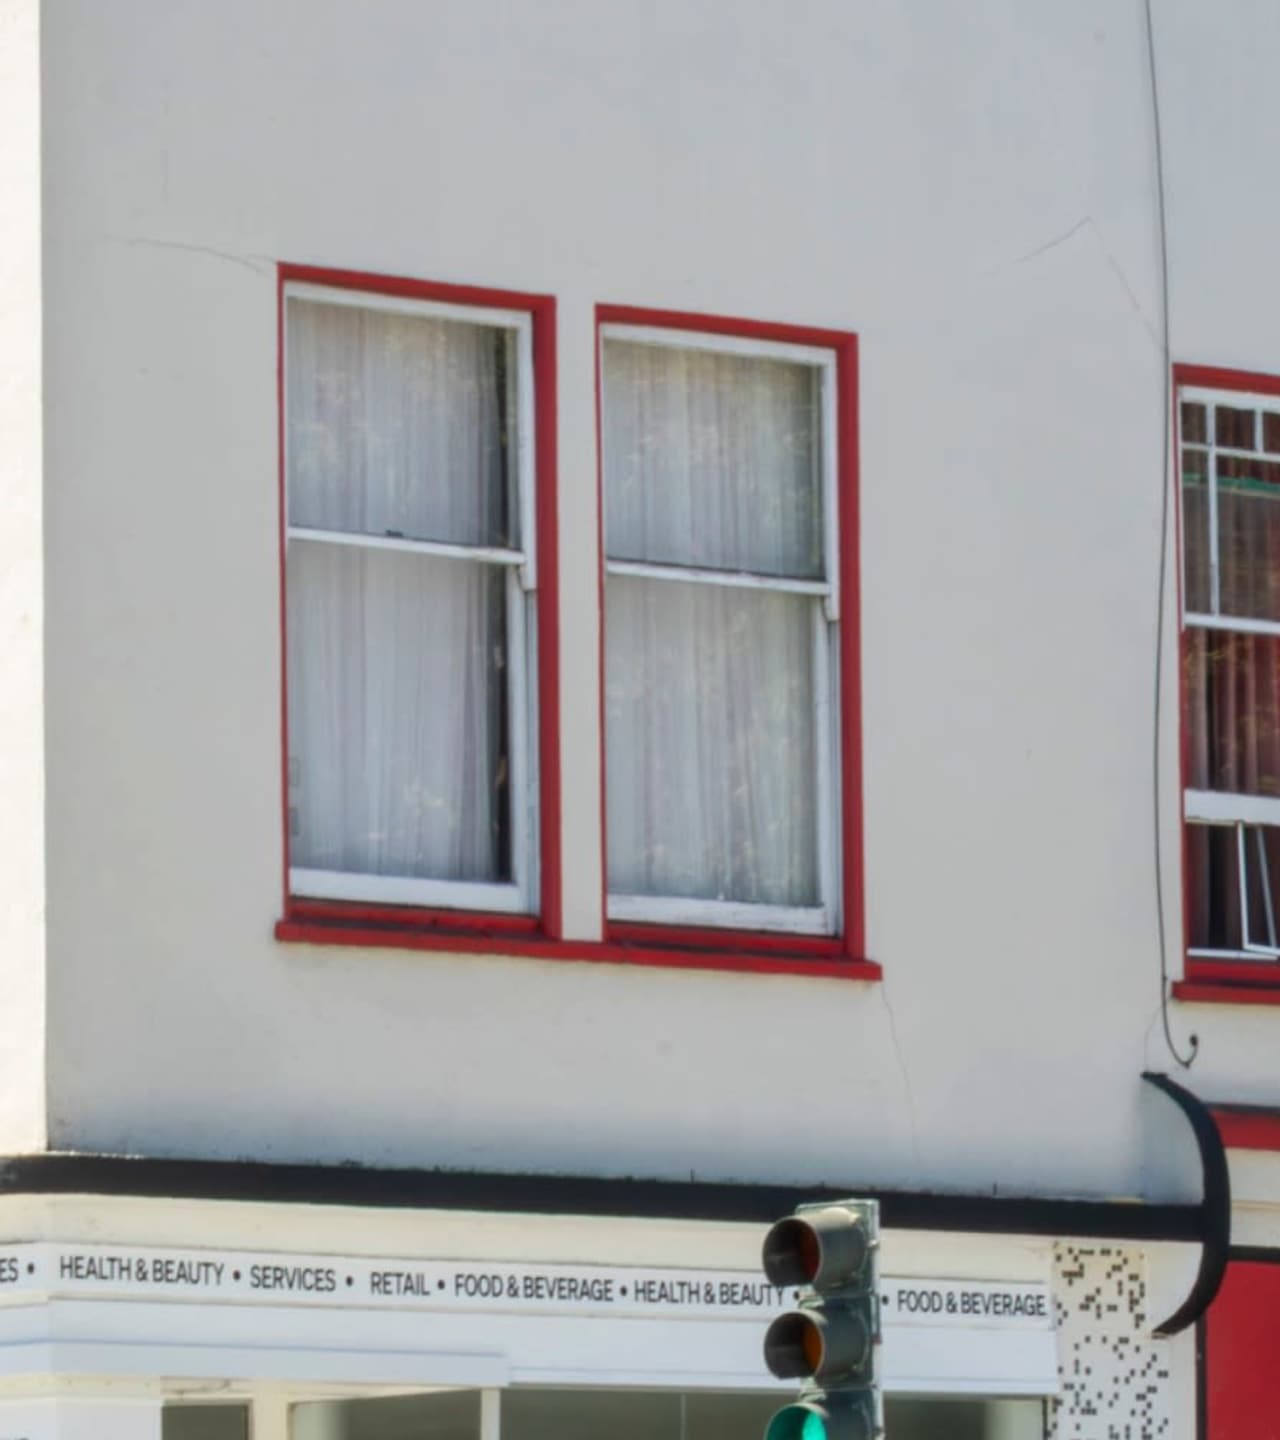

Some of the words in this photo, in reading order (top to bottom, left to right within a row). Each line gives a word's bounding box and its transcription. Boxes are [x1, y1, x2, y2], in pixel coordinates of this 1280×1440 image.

[60, 1256, 131, 1280] HEALTH
[135, 1258, 148, 1282] &
[152, 1259, 225, 1286] BEAUTY
[250, 1265, 337, 1292] SERVICES
[370, 1272, 430, 1296] RETAIL
[454, 1274, 504, 1298] FOOD
[506, 1275, 519, 1298] &
[523, 1276, 614, 1301] BEVERAGE
[634, 1279, 700, 1304] HEALTH
[719, 1282, 783, 1306] BEAUTY
[897, 1290, 942, 1313] FOOD
[960, 1292, 1047, 1316] BEVERAGE
